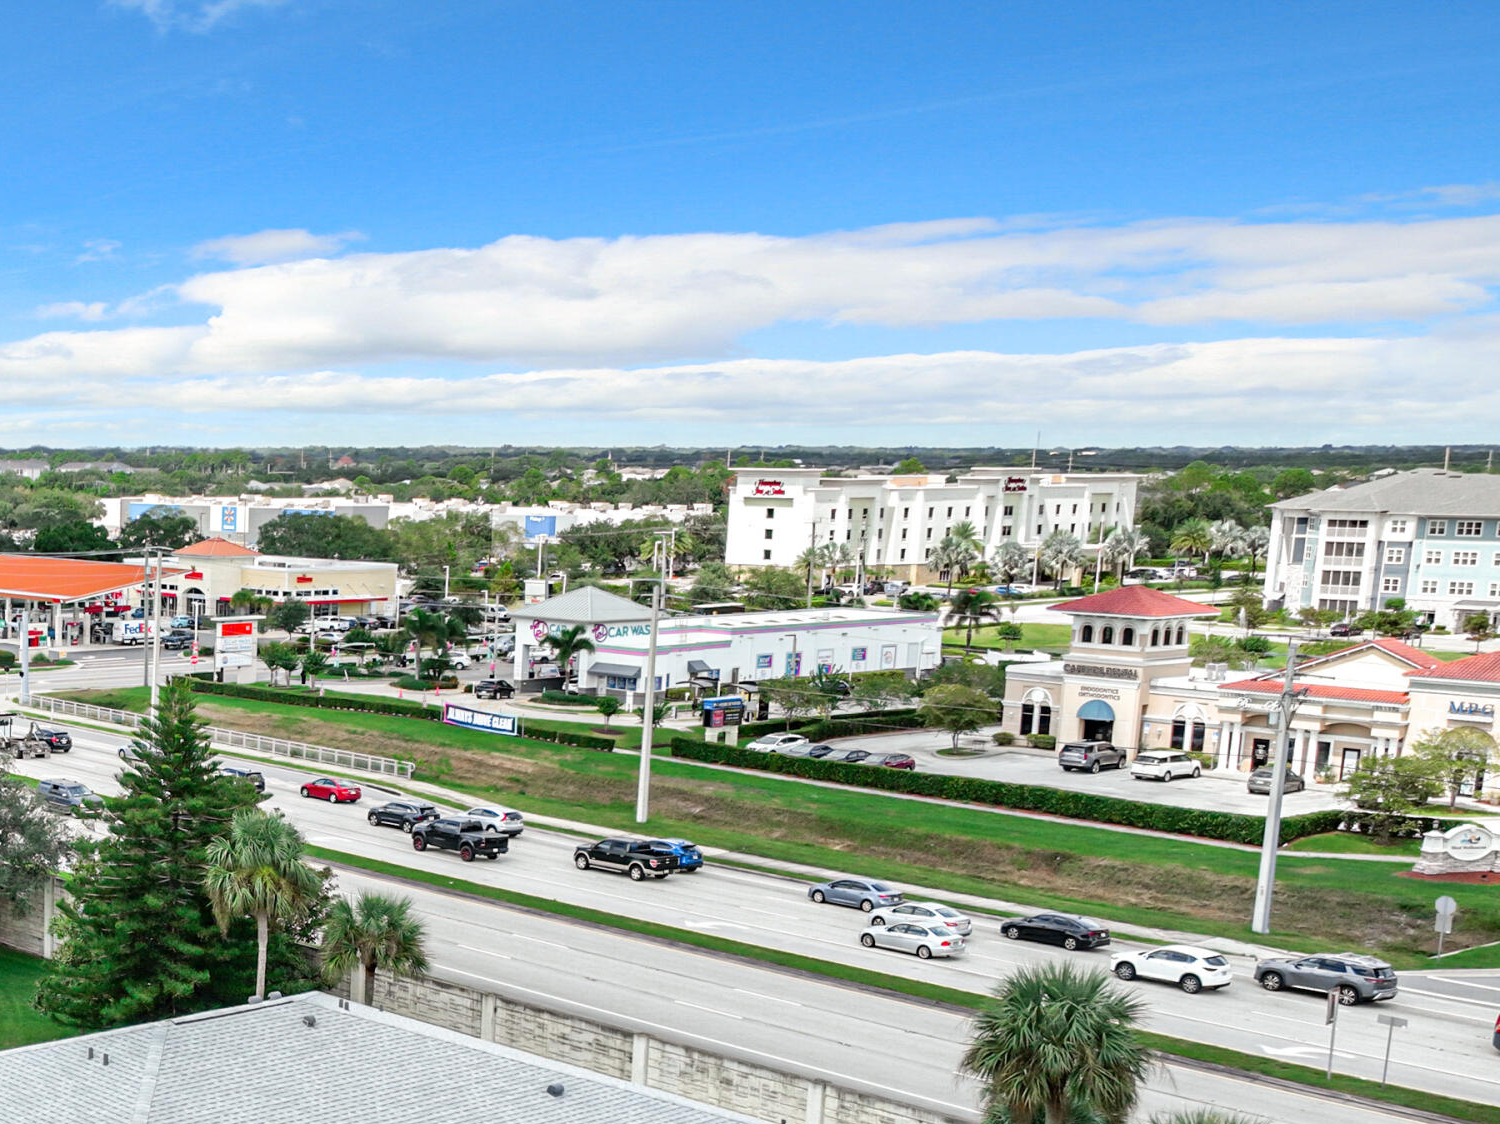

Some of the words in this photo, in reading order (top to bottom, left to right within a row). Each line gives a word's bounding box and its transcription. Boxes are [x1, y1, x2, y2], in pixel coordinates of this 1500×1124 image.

[608, 625, 629, 638] CAR
[631, 624, 651, 636] WAS
[1077, 691, 1121, 701] ORTHODONTICS
[1080, 686, 1119, 695] ENDODONTICS
[447, 706, 474, 723] ALWAYS
[491, 716, 514, 731] CLEAN
